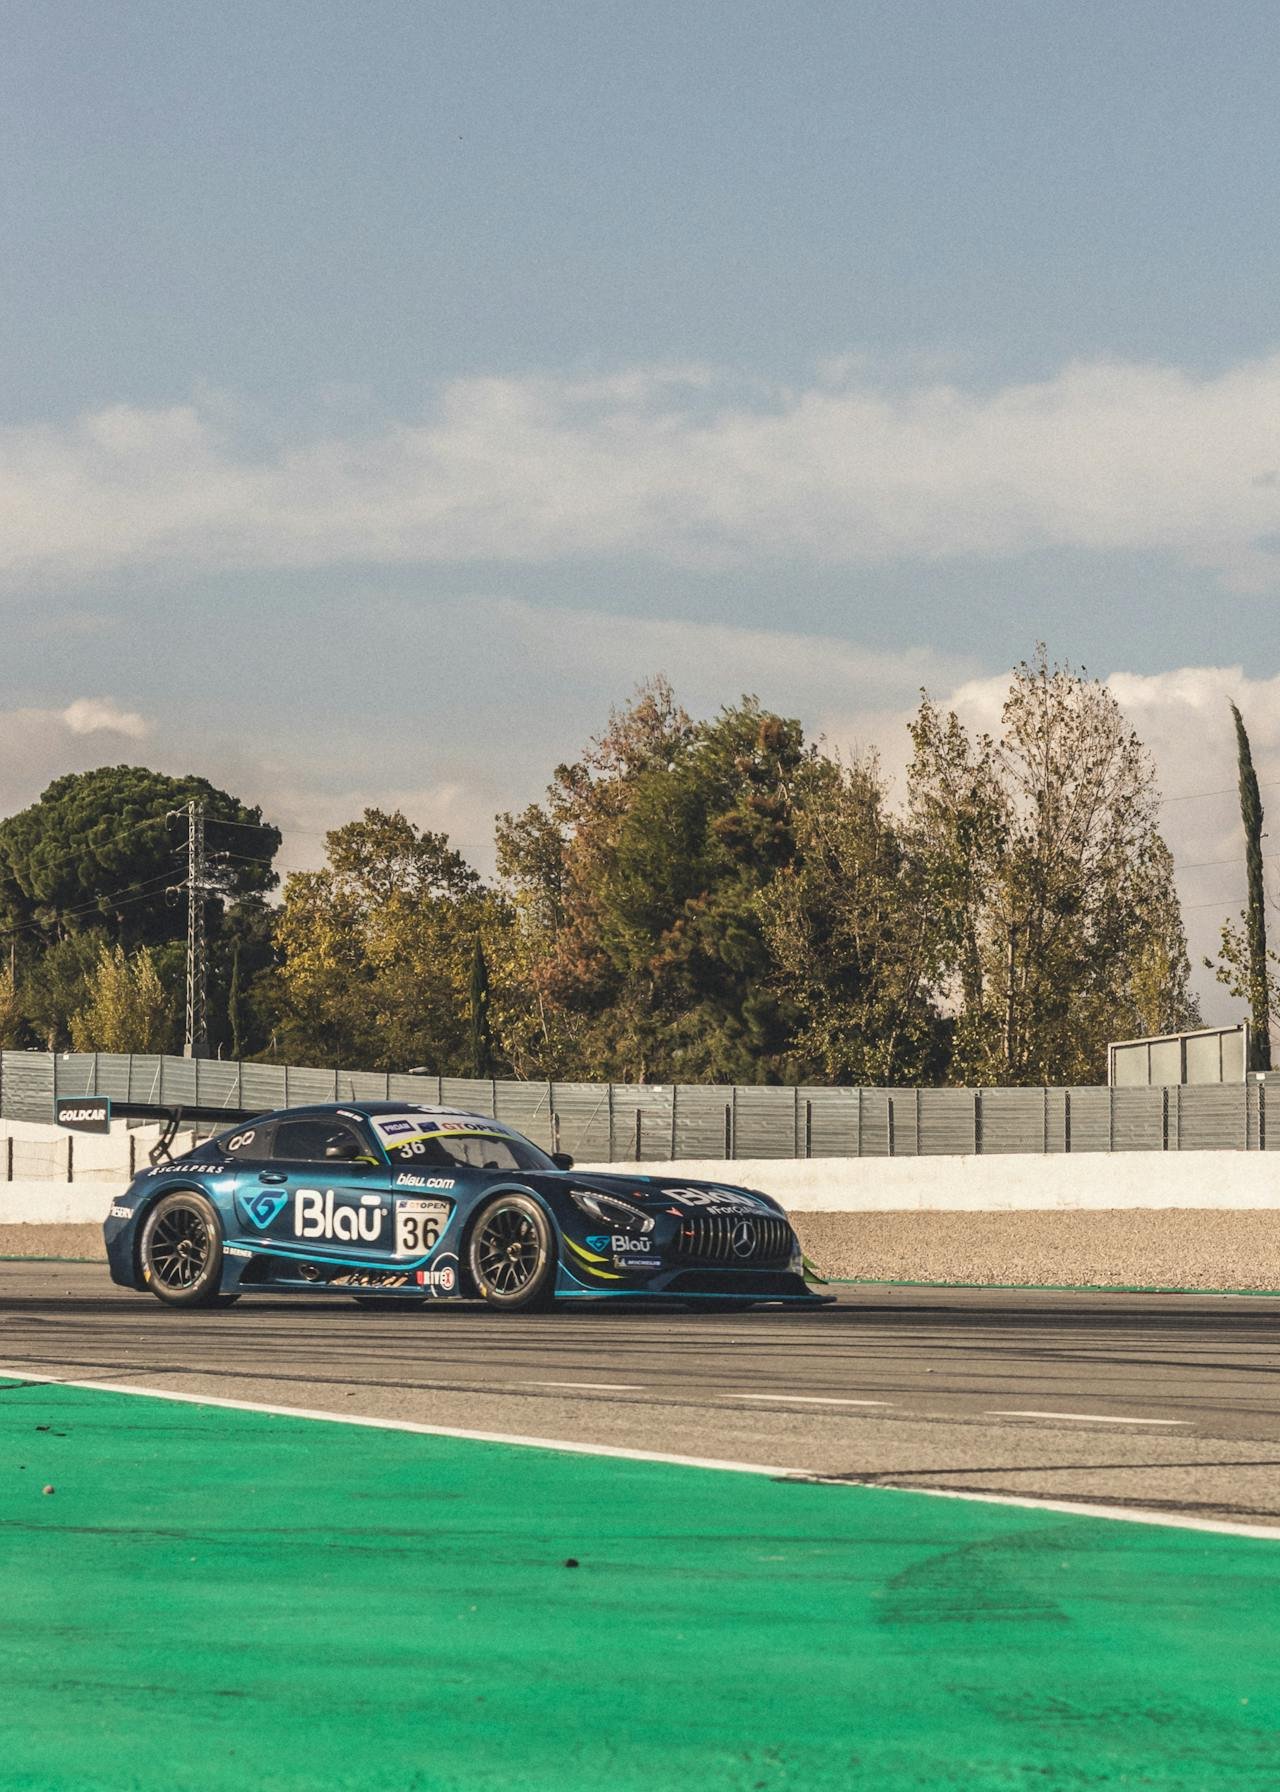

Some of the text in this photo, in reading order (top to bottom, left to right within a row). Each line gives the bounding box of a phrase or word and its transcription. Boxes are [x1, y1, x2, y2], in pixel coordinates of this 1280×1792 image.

[58, 1109, 106, 1122] GOLDCAR
[399, 1139, 426, 1159] 36
[147, 1164, 225, 1177] ASCALPERS
[396, 1173, 456, 1189] blau.com
[402, 1216, 440, 1251] 36
